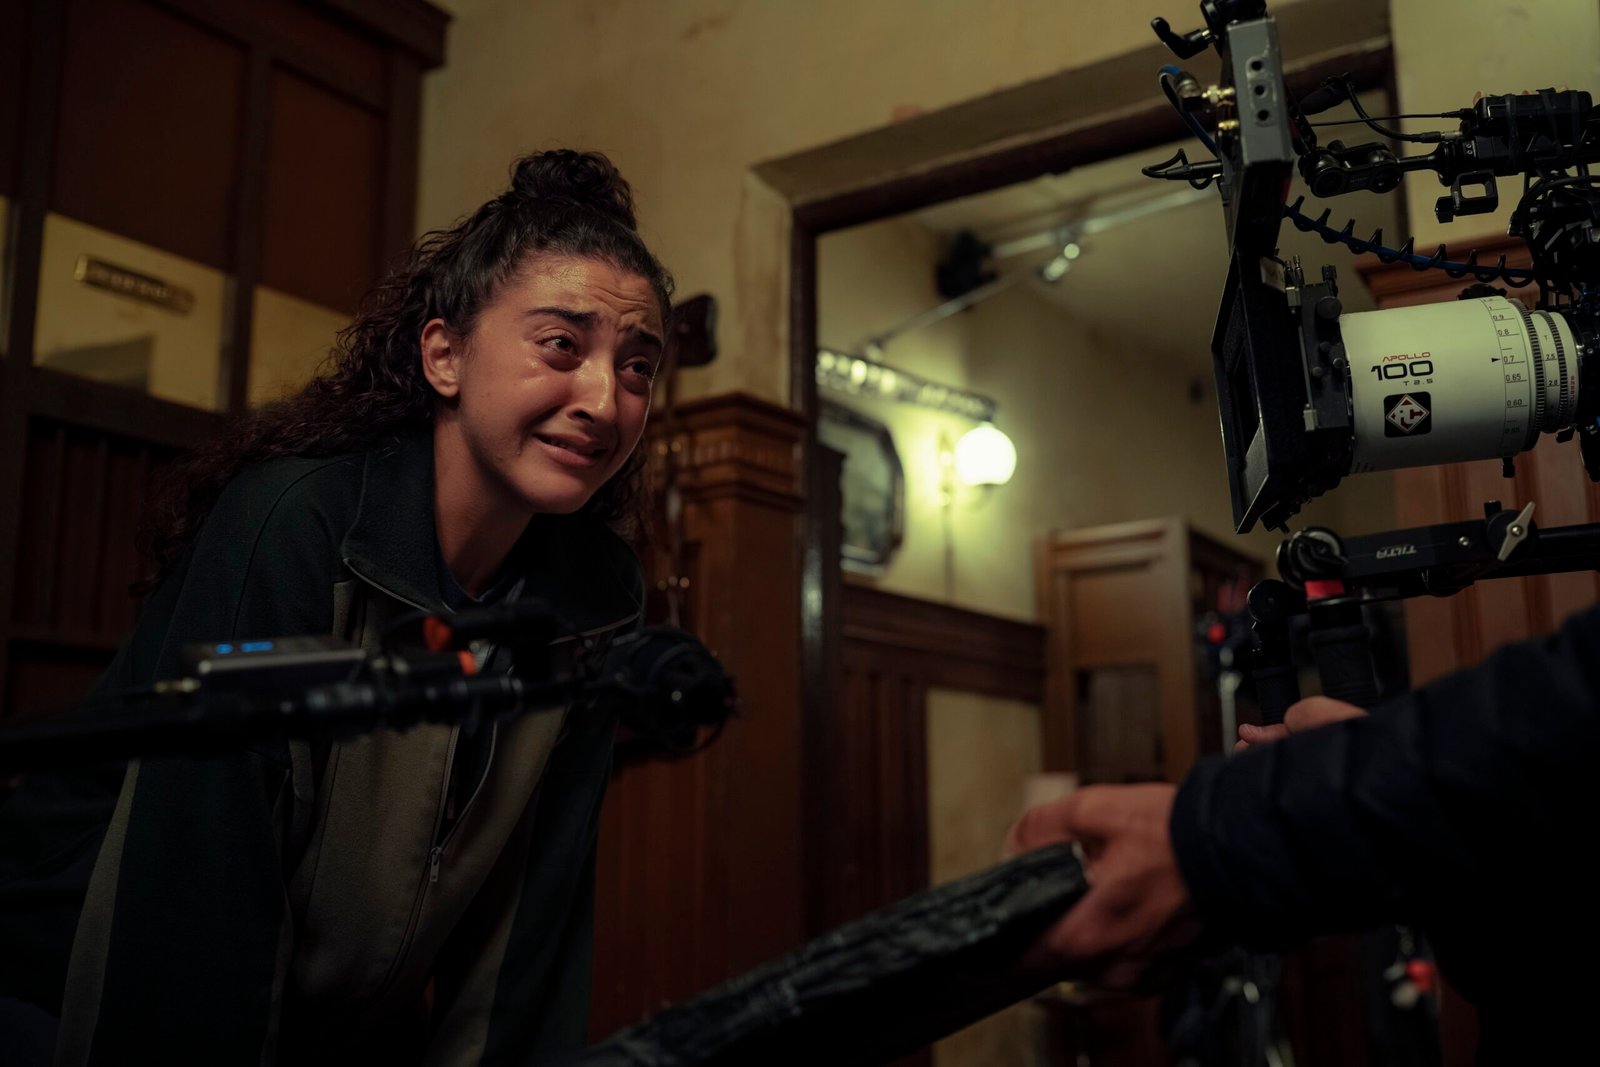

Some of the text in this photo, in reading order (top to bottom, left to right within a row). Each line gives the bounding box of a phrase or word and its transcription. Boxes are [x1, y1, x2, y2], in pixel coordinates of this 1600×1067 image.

[1497, 328, 1510, 336] 0.8
[1382, 352, 1431, 363] APOLLO
[1503, 355, 1515, 363] 0.7
[1371, 360, 1434, 381] 100
[1505, 373, 1521, 382] 0.65
[1506, 398, 1523, 407] 0.60
[1376, 544, 1417, 559] TILTA
